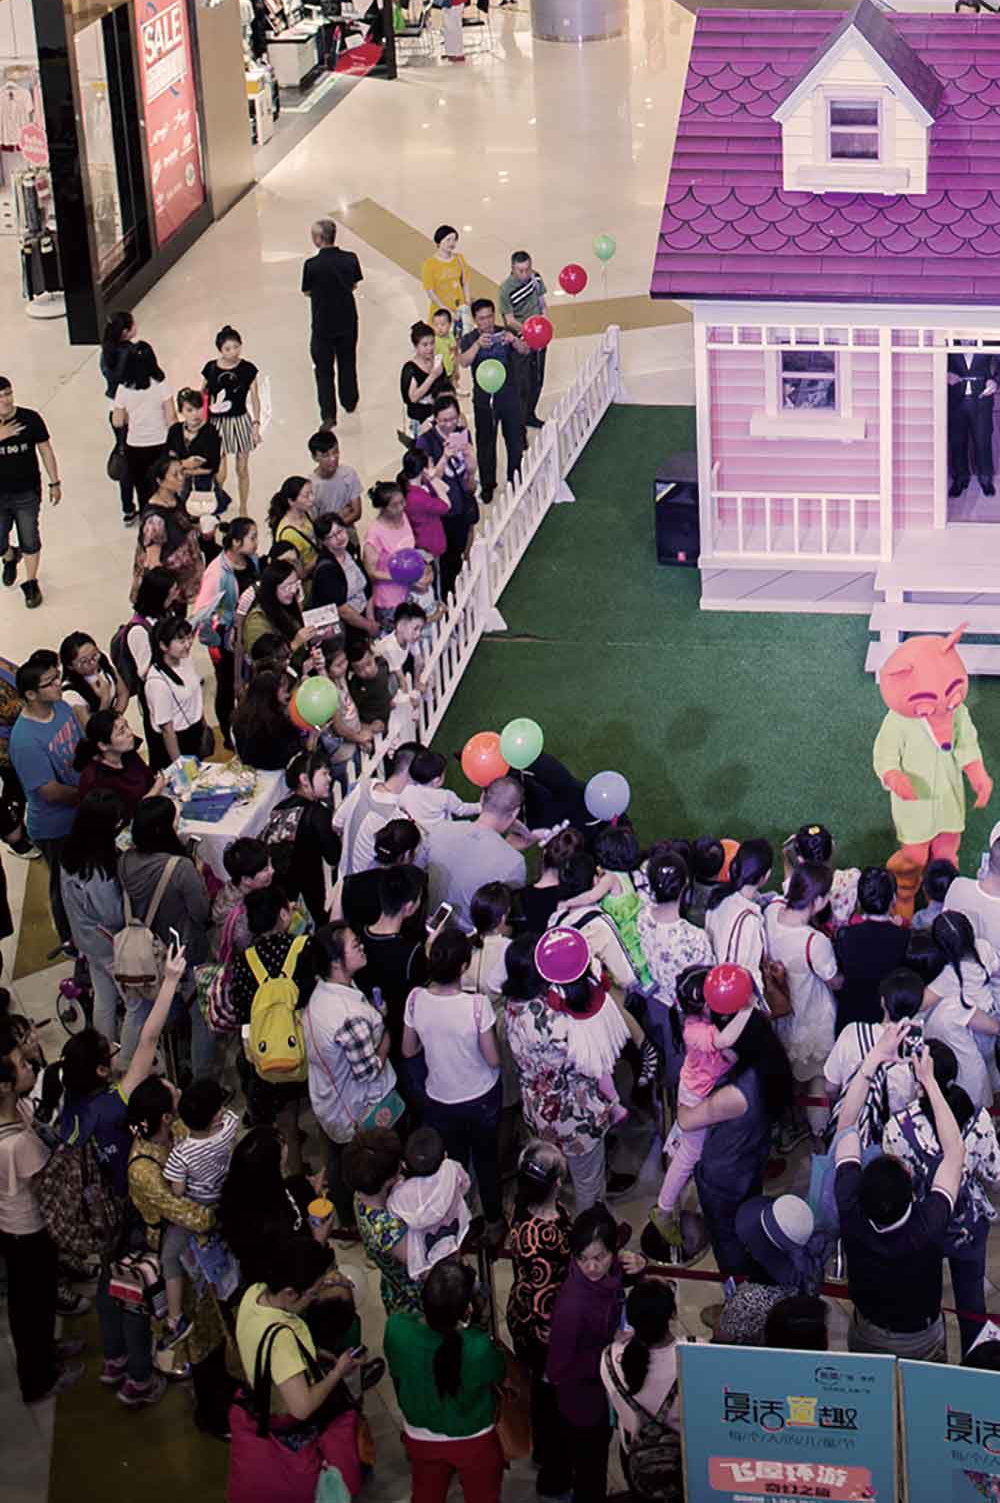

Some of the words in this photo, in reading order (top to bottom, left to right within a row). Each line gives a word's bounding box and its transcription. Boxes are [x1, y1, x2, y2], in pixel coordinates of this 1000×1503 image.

[143, 6, 184, 64] SALE
[719, 1460, 849, 1487] 飞屋环游
